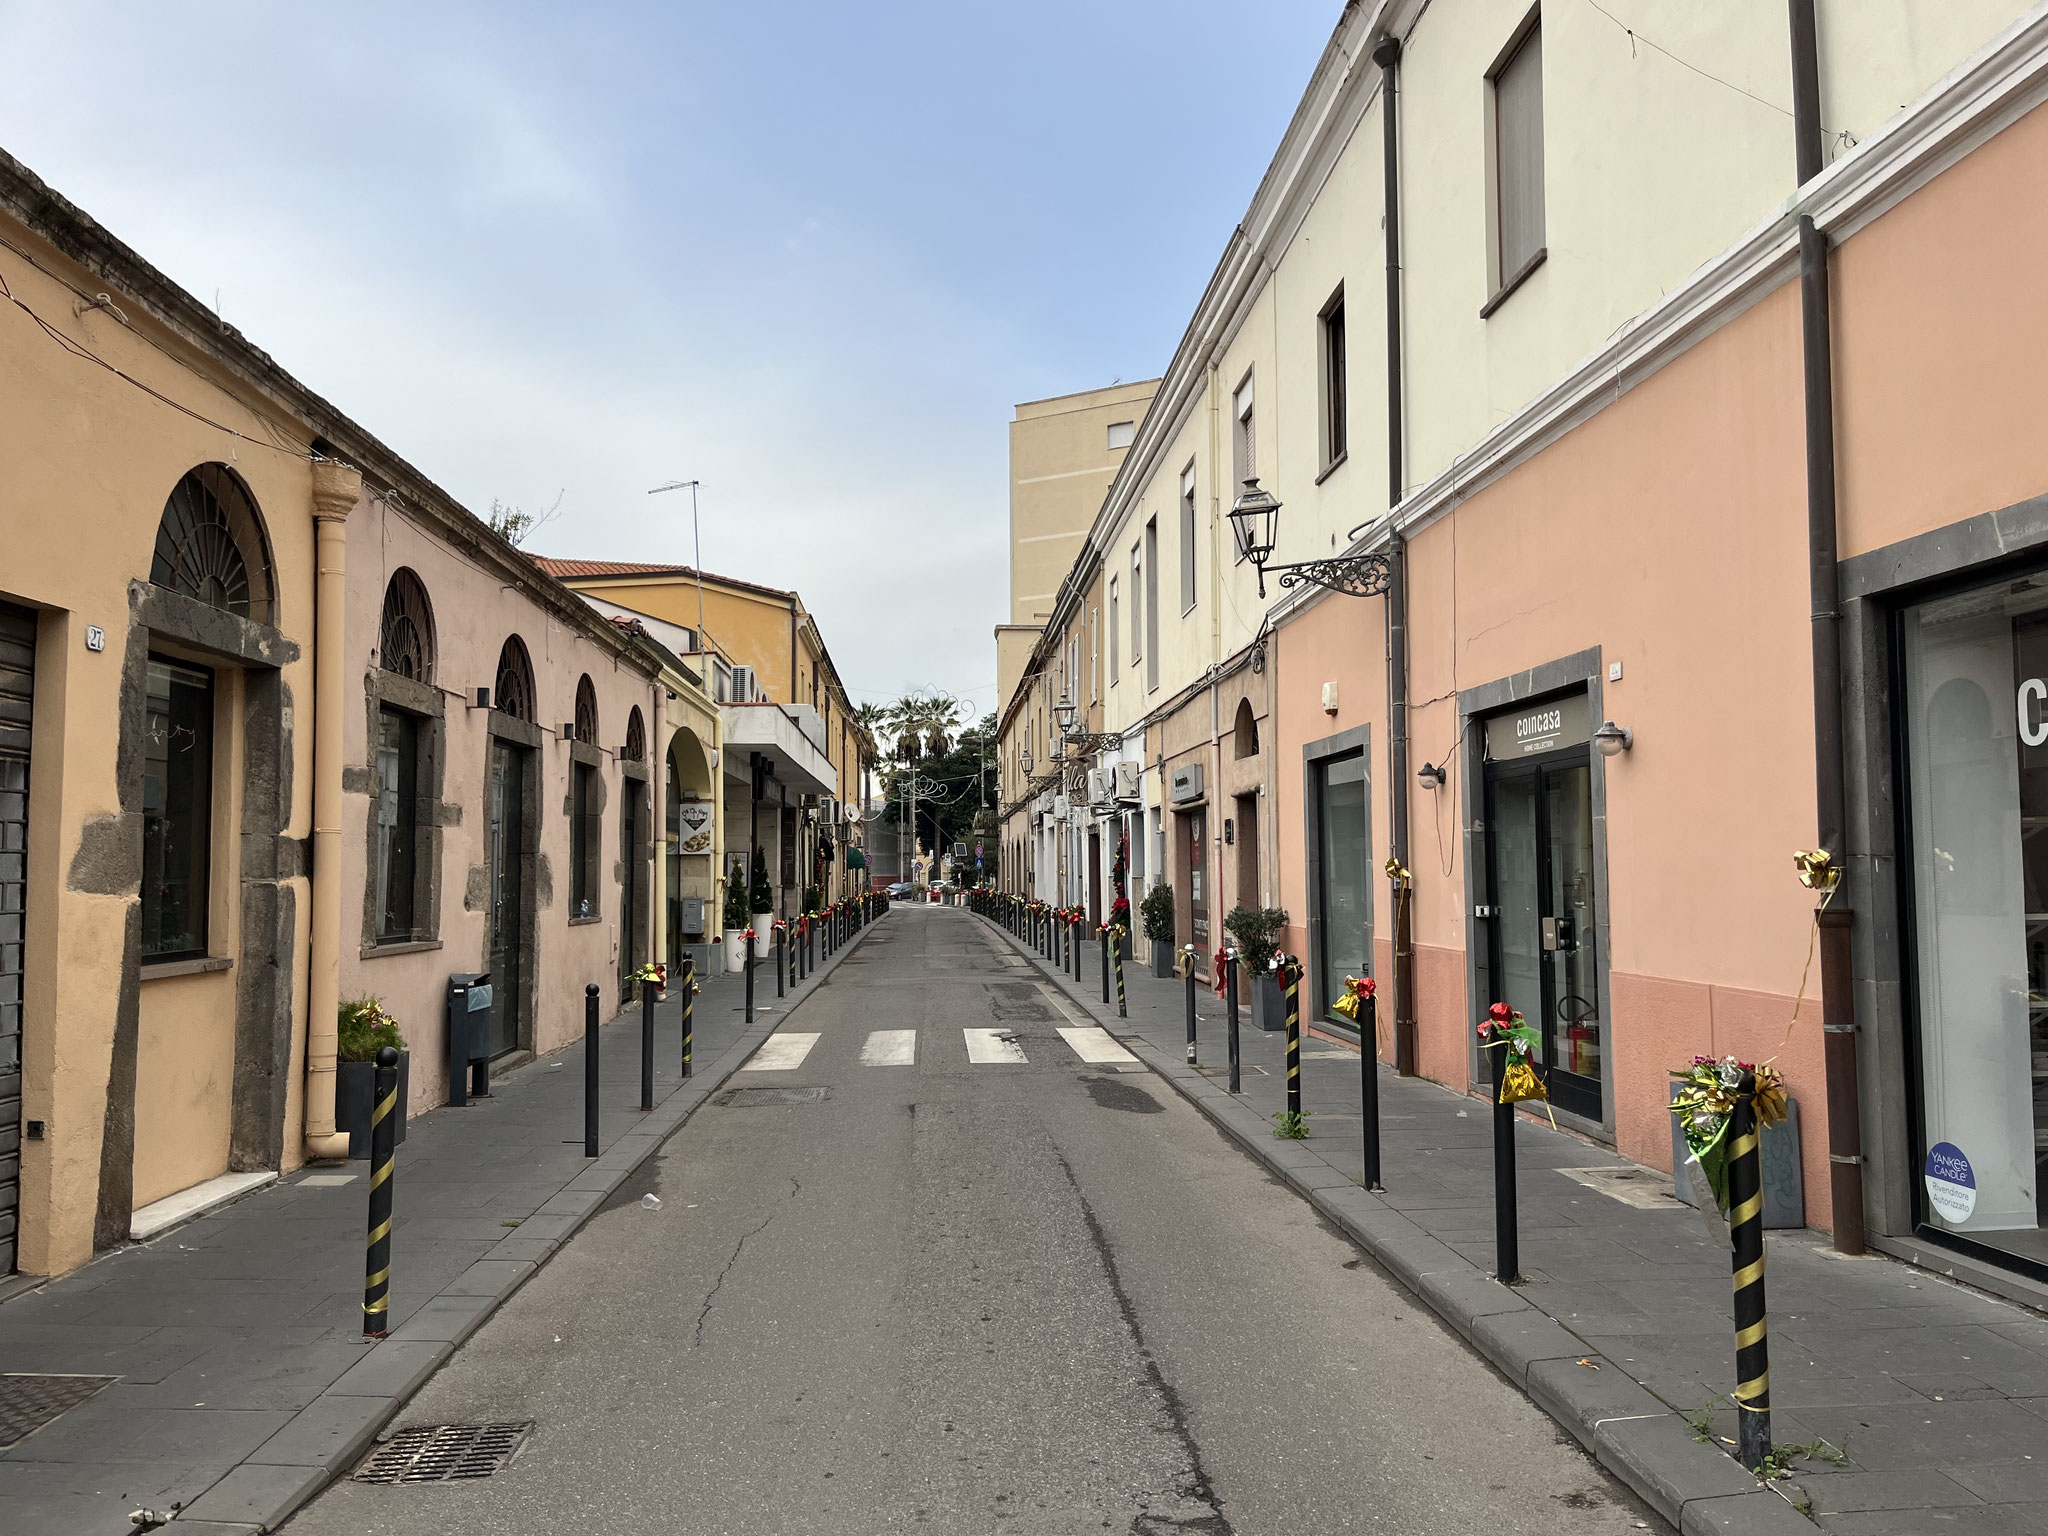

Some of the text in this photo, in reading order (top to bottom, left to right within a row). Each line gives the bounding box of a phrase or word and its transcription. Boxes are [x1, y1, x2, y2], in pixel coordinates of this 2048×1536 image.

[90, 628, 102, 648] 27
[1523, 740, 1554, 752] HOME COLLECTION
[1932, 1181, 1969, 1201] Rivenditore
[1933, 1193, 1970, 1212] Autorizzato
